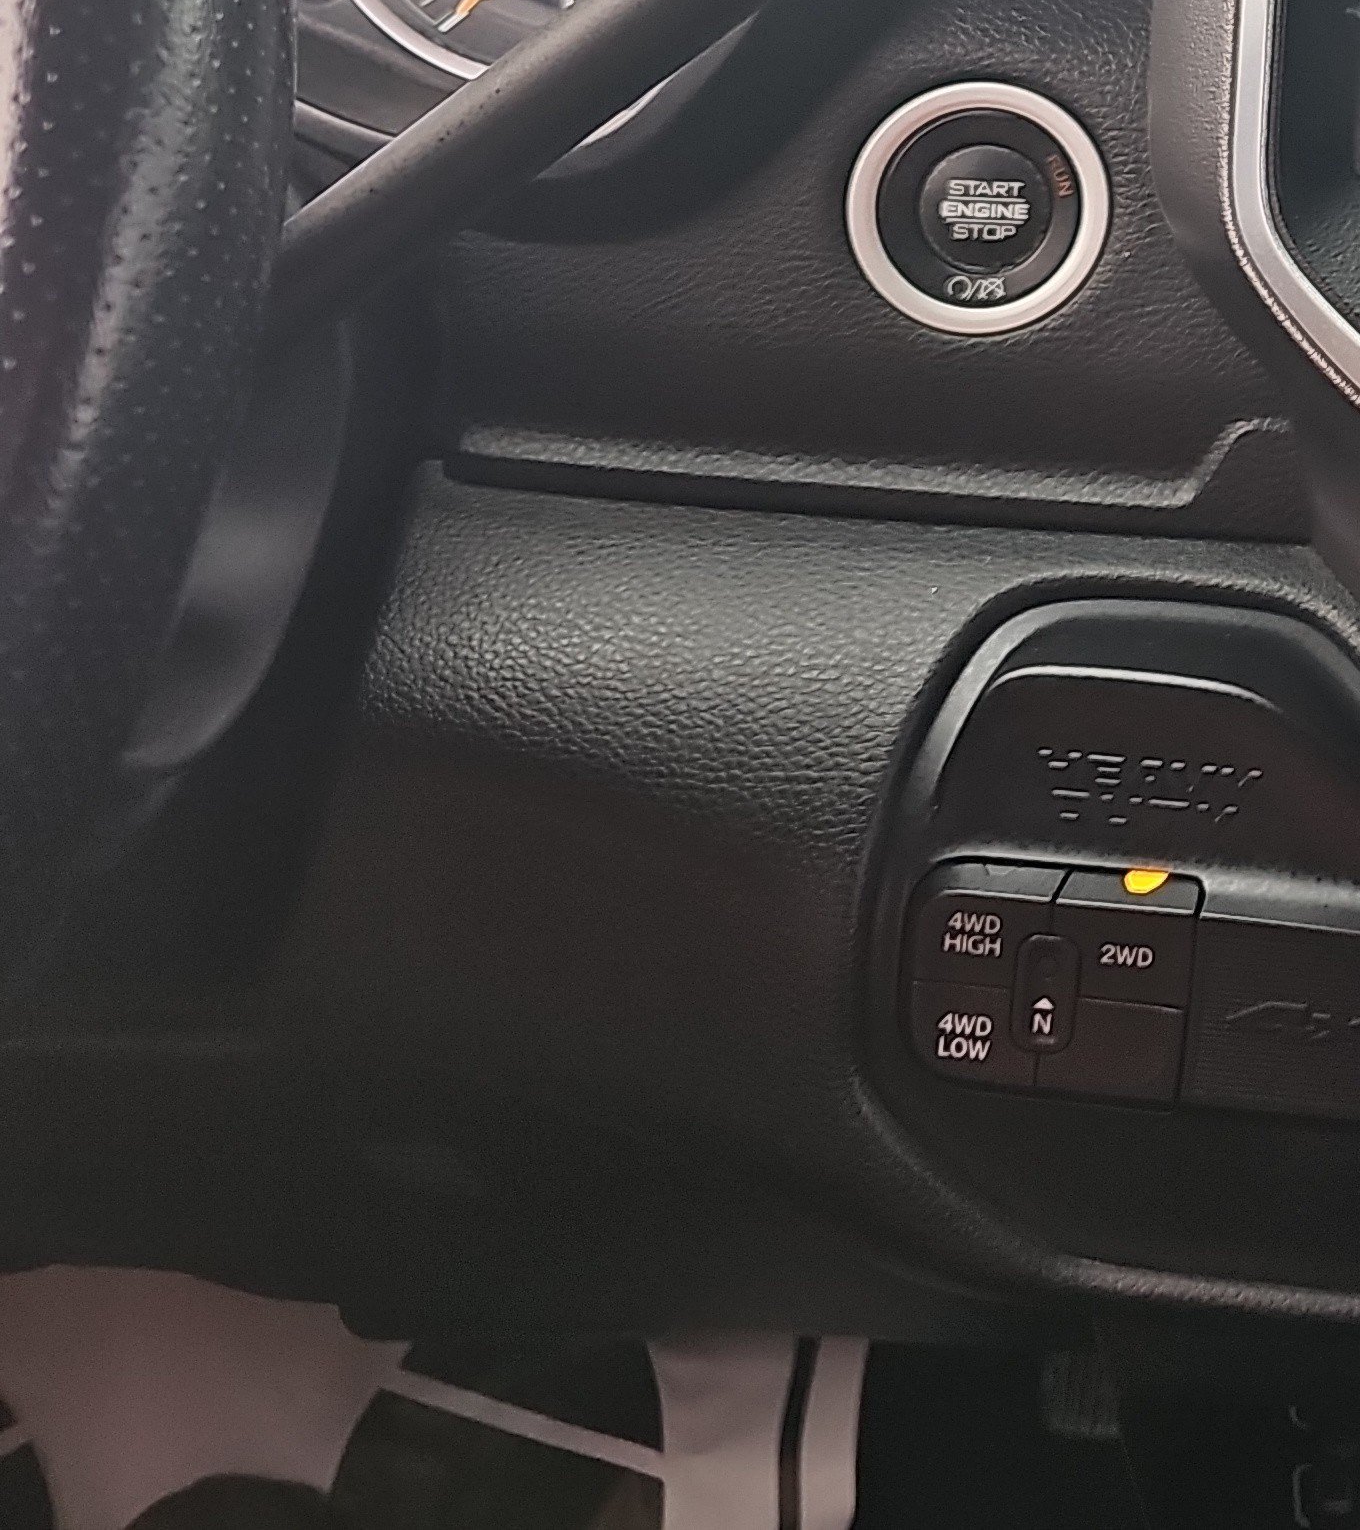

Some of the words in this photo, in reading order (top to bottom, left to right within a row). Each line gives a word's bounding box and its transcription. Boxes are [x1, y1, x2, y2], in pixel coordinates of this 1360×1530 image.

[949, 180, 1025, 197] START
[1047, 154, 1075, 199] RUN
[942, 201, 1030, 220] ENGINE
[952, 223, 1017, 241] STOP
[948, 911, 1001, 935] 4WD
[943, 933, 1002, 957] HIGH
[1100, 944, 1153, 968] 2WD
[937, 1013, 992, 1037] 4WD
[1032, 1013, 1053, 1035] N
[937, 1035, 992, 1061] LOW
